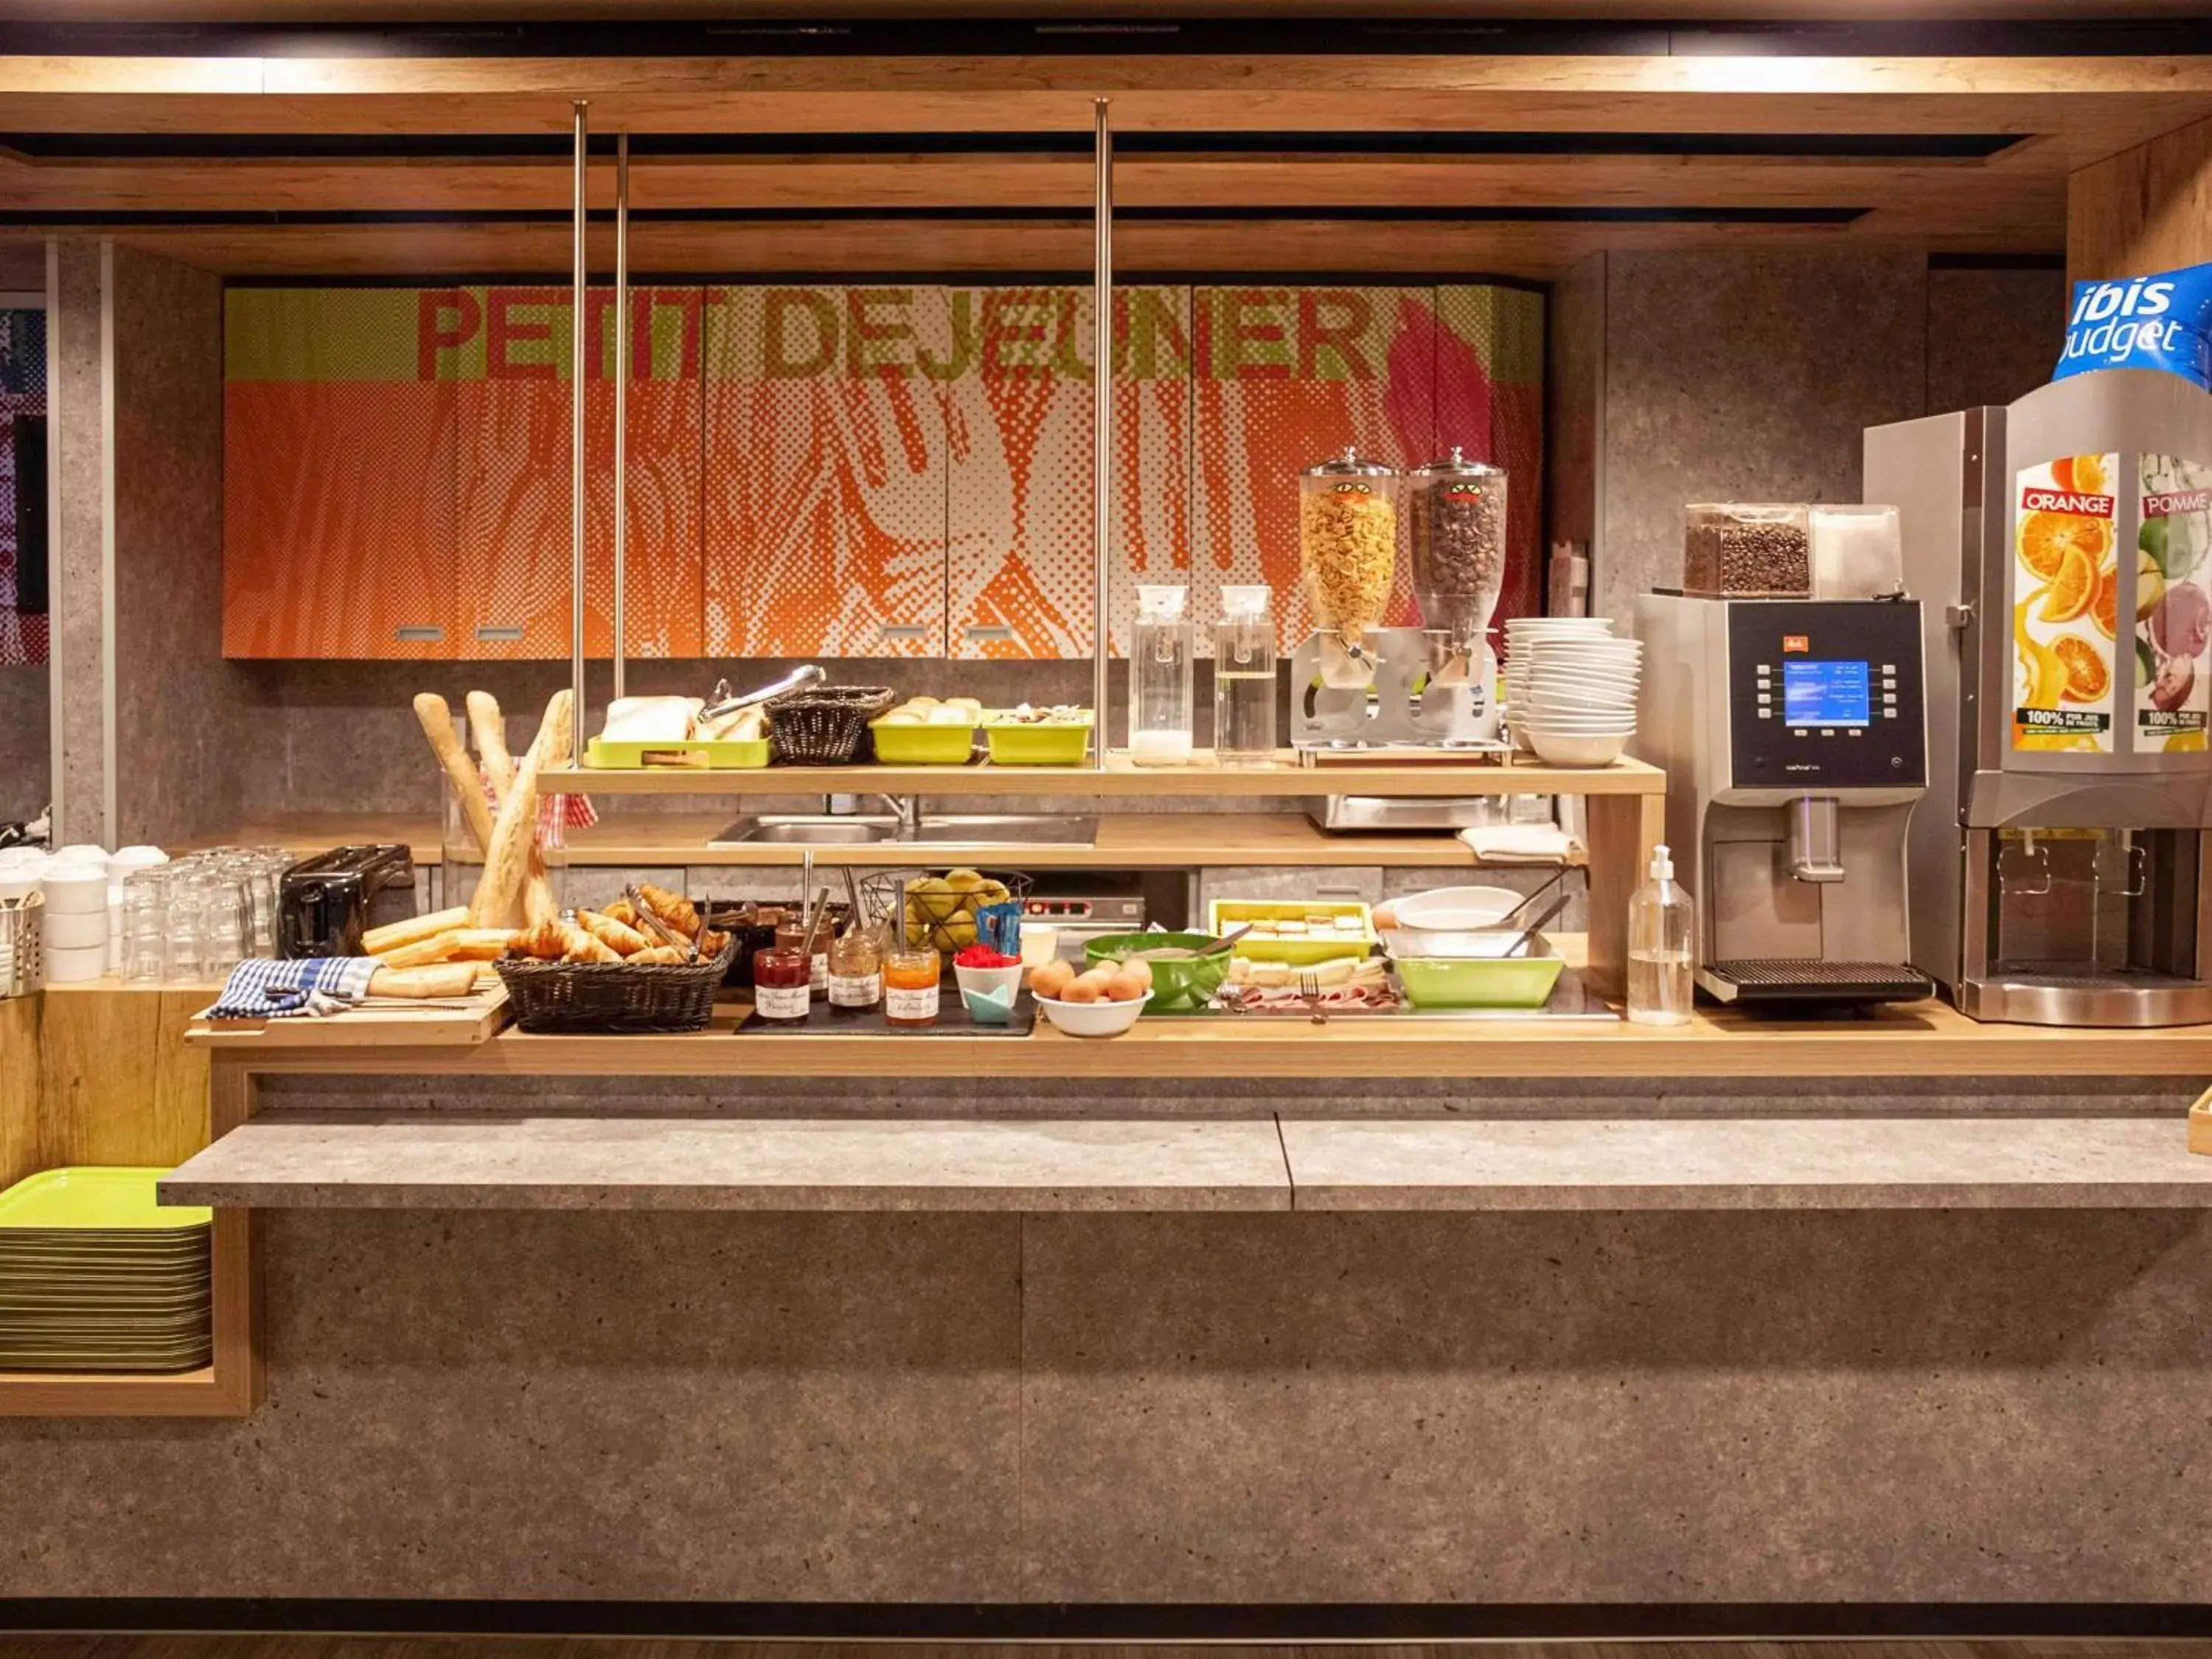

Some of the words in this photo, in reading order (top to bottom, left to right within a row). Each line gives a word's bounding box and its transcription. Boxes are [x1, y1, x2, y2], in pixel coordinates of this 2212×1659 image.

[2071, 276, 2175, 325] ibis
[418, 288, 726, 380] PETIT
[2026, 493, 2110, 514] ORANGE
[2147, 493, 2208, 514] POMME
[2026, 709, 2065, 726] 100%
[2148, 711, 2178, 726] 100%
